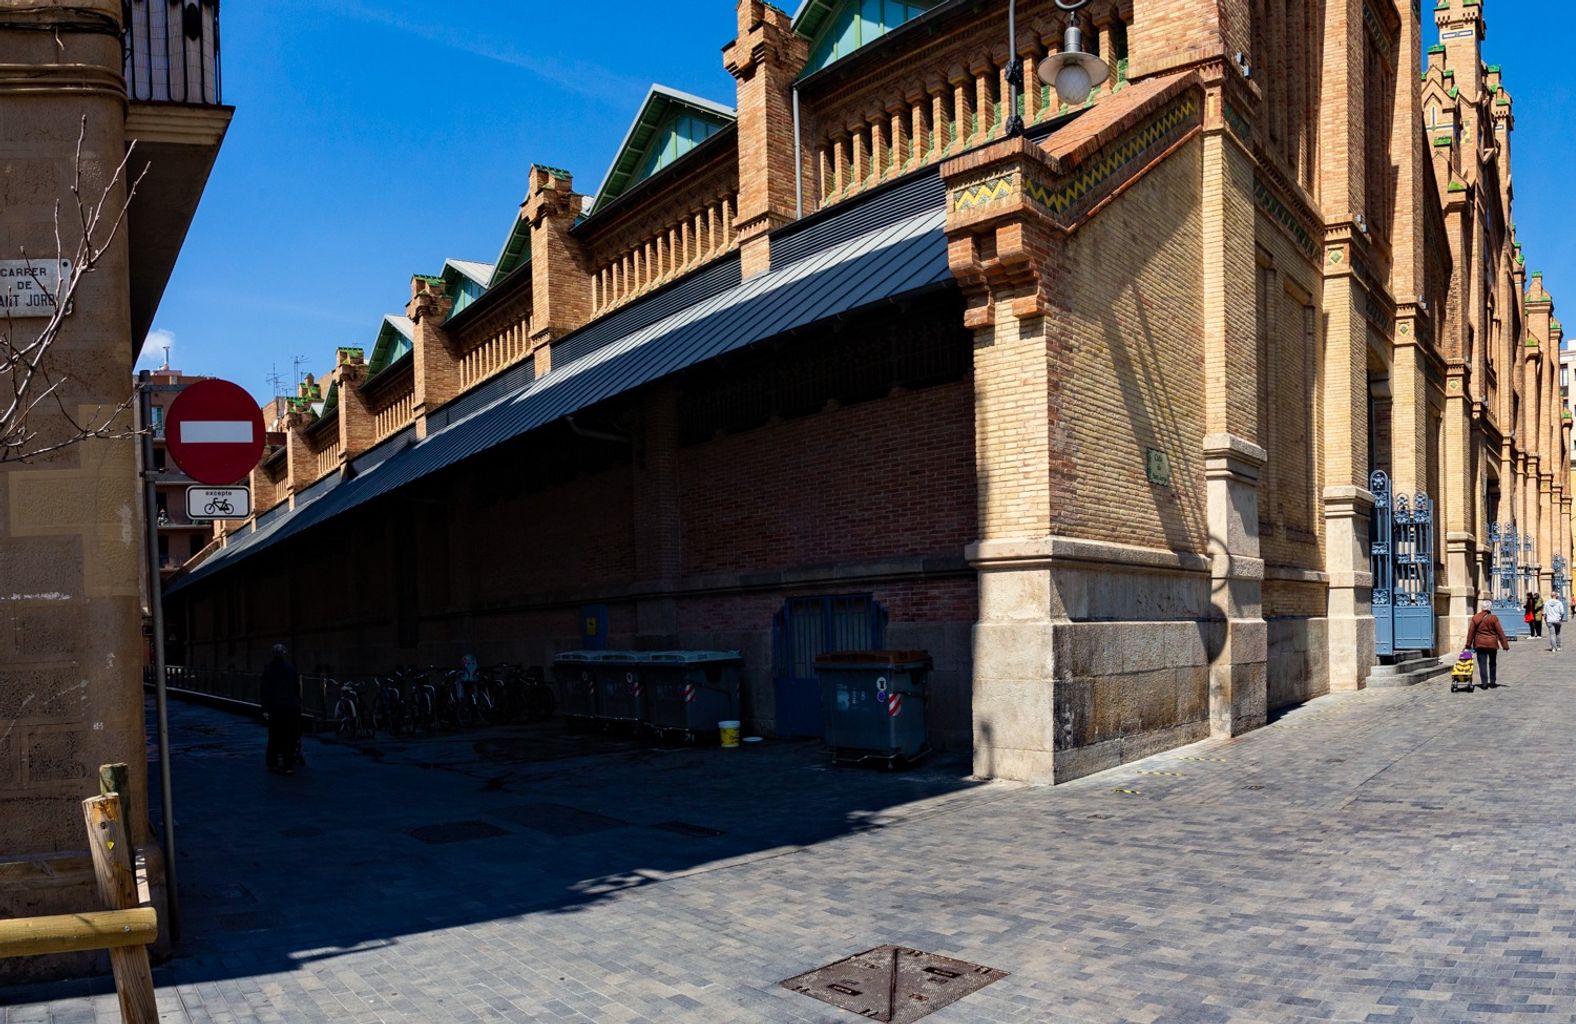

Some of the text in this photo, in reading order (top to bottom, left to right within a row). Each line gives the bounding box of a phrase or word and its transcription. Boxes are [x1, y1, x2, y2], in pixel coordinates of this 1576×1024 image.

[0, 267, 47, 278] CARRER
[17, 281, 32, 290] DE
[0, 294, 57, 307] ANT JORD
